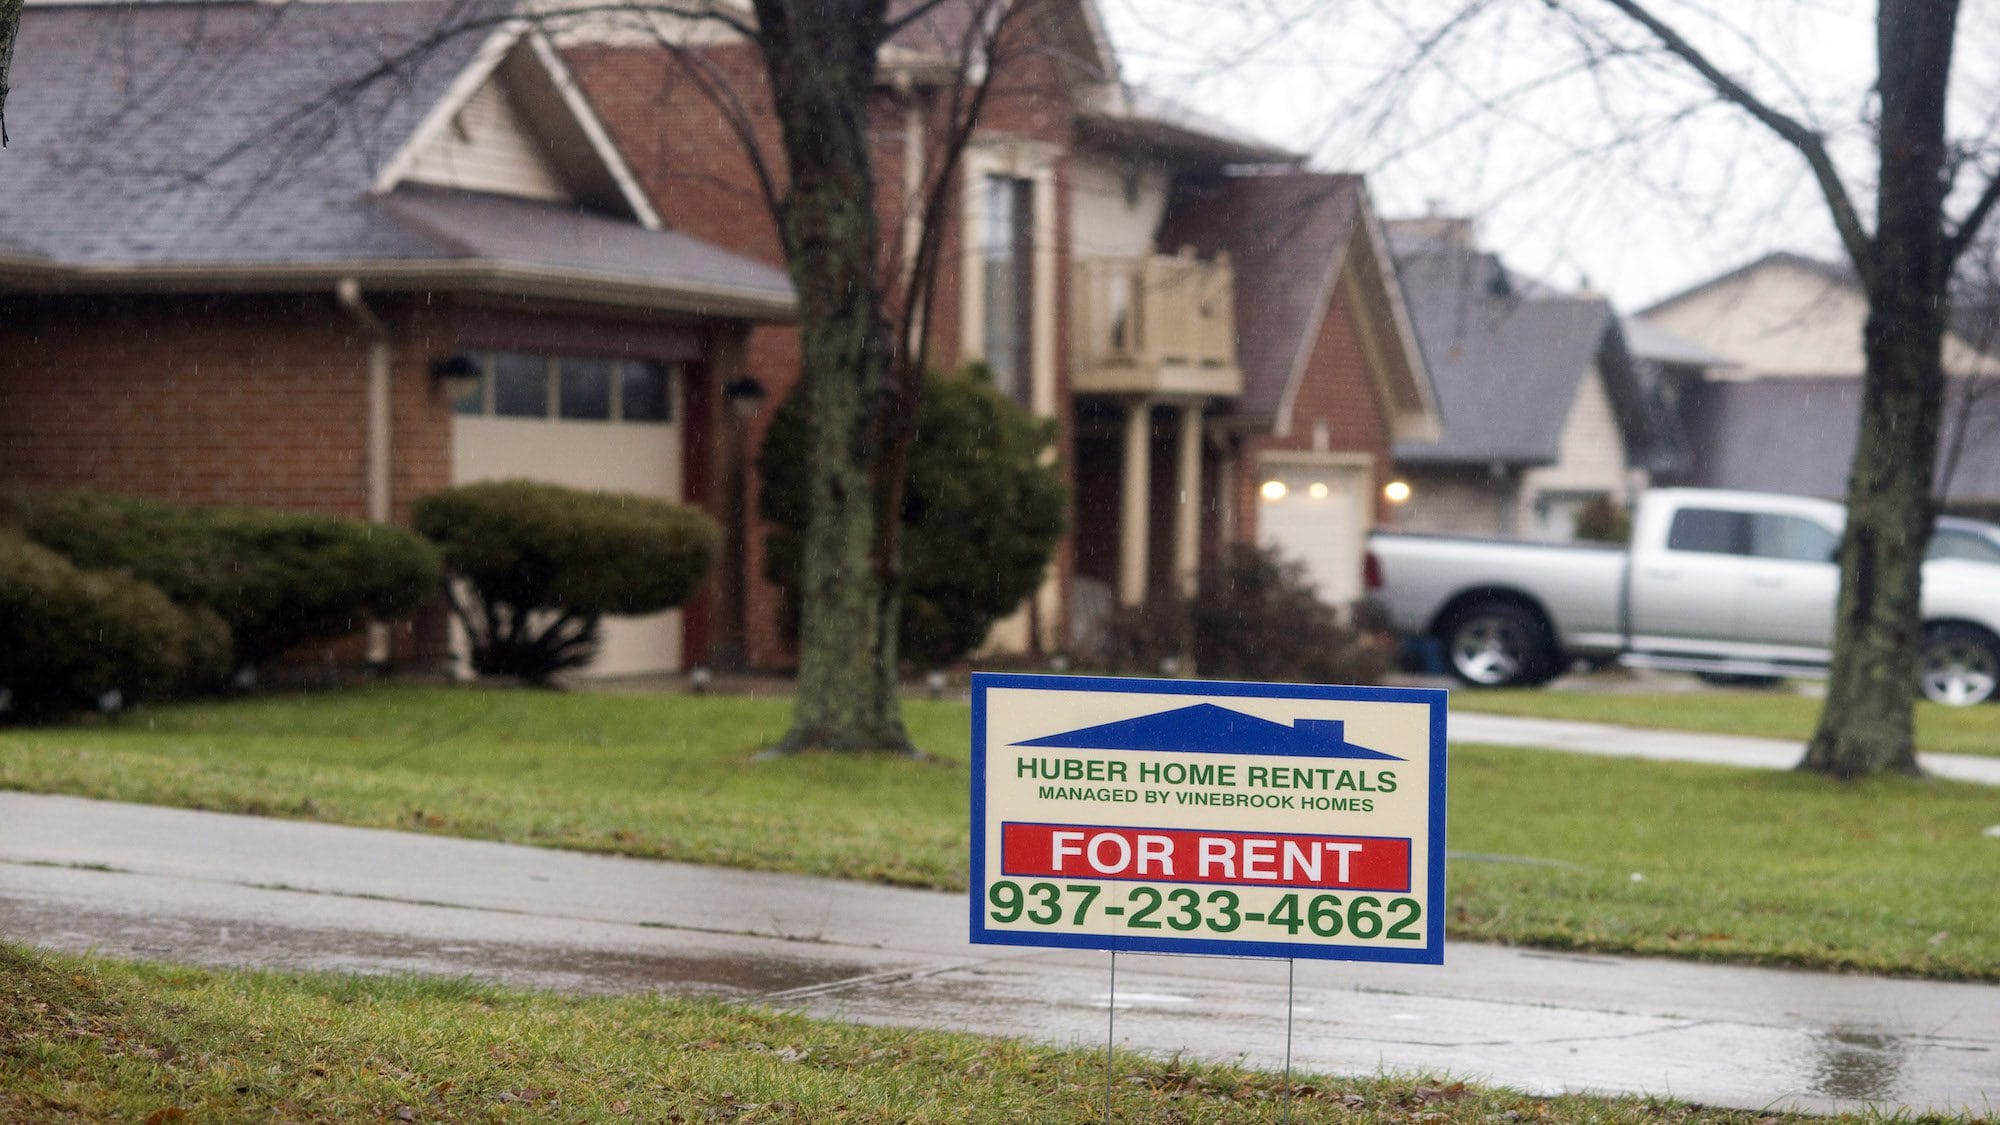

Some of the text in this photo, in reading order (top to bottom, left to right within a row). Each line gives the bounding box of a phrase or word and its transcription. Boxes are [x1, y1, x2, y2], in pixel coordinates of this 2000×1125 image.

[1017, 757, 1397, 793] HUBER HOME RENTALS
[1039, 786, 1374, 812] MANAGED BY VINEBROOK HOMES
[1052, 831, 1363, 883] FOR RENT
[989, 881, 1422, 940] 937-233-4662
